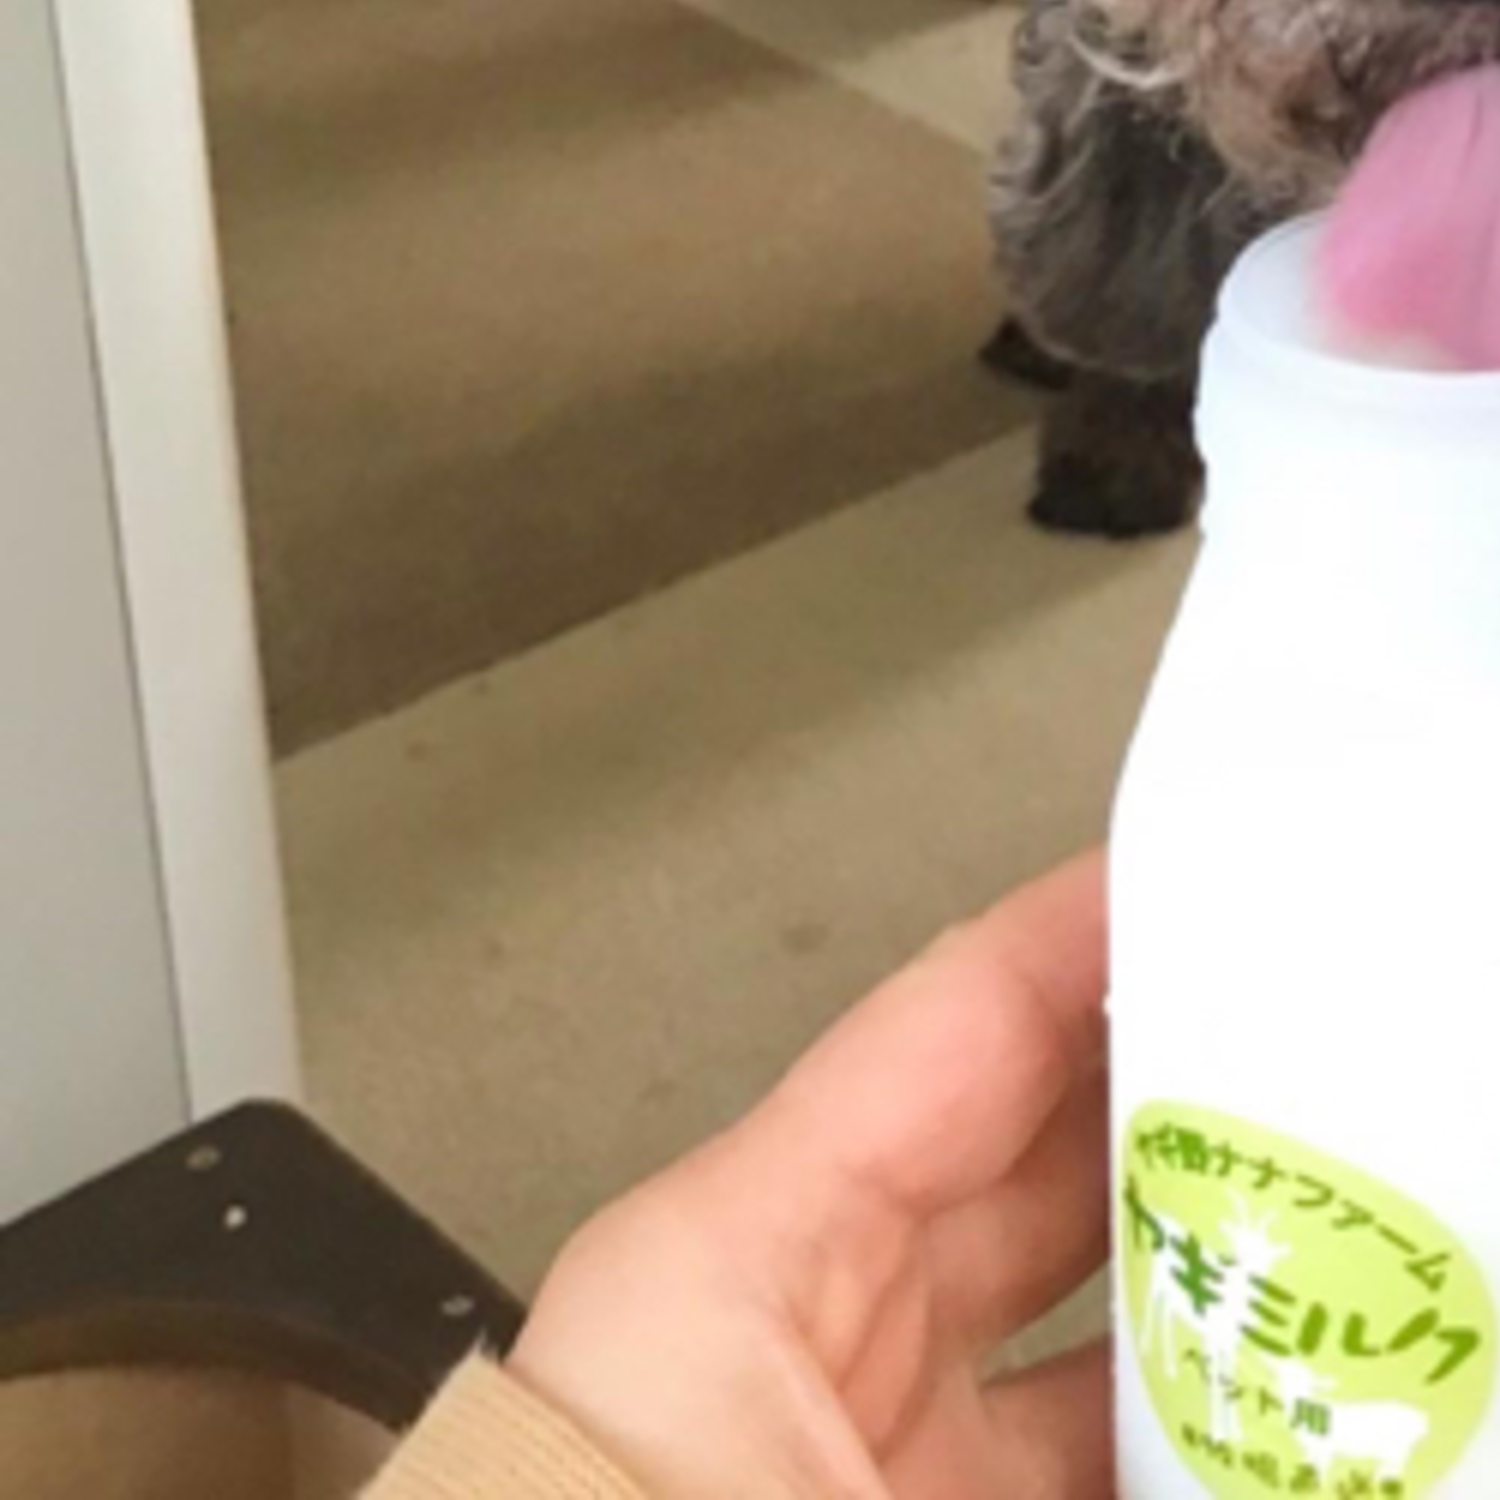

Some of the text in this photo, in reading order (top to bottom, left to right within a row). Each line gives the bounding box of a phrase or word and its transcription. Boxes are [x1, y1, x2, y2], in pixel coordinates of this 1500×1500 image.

[1123, 1174, 1482, 1384] ヤギミルク
